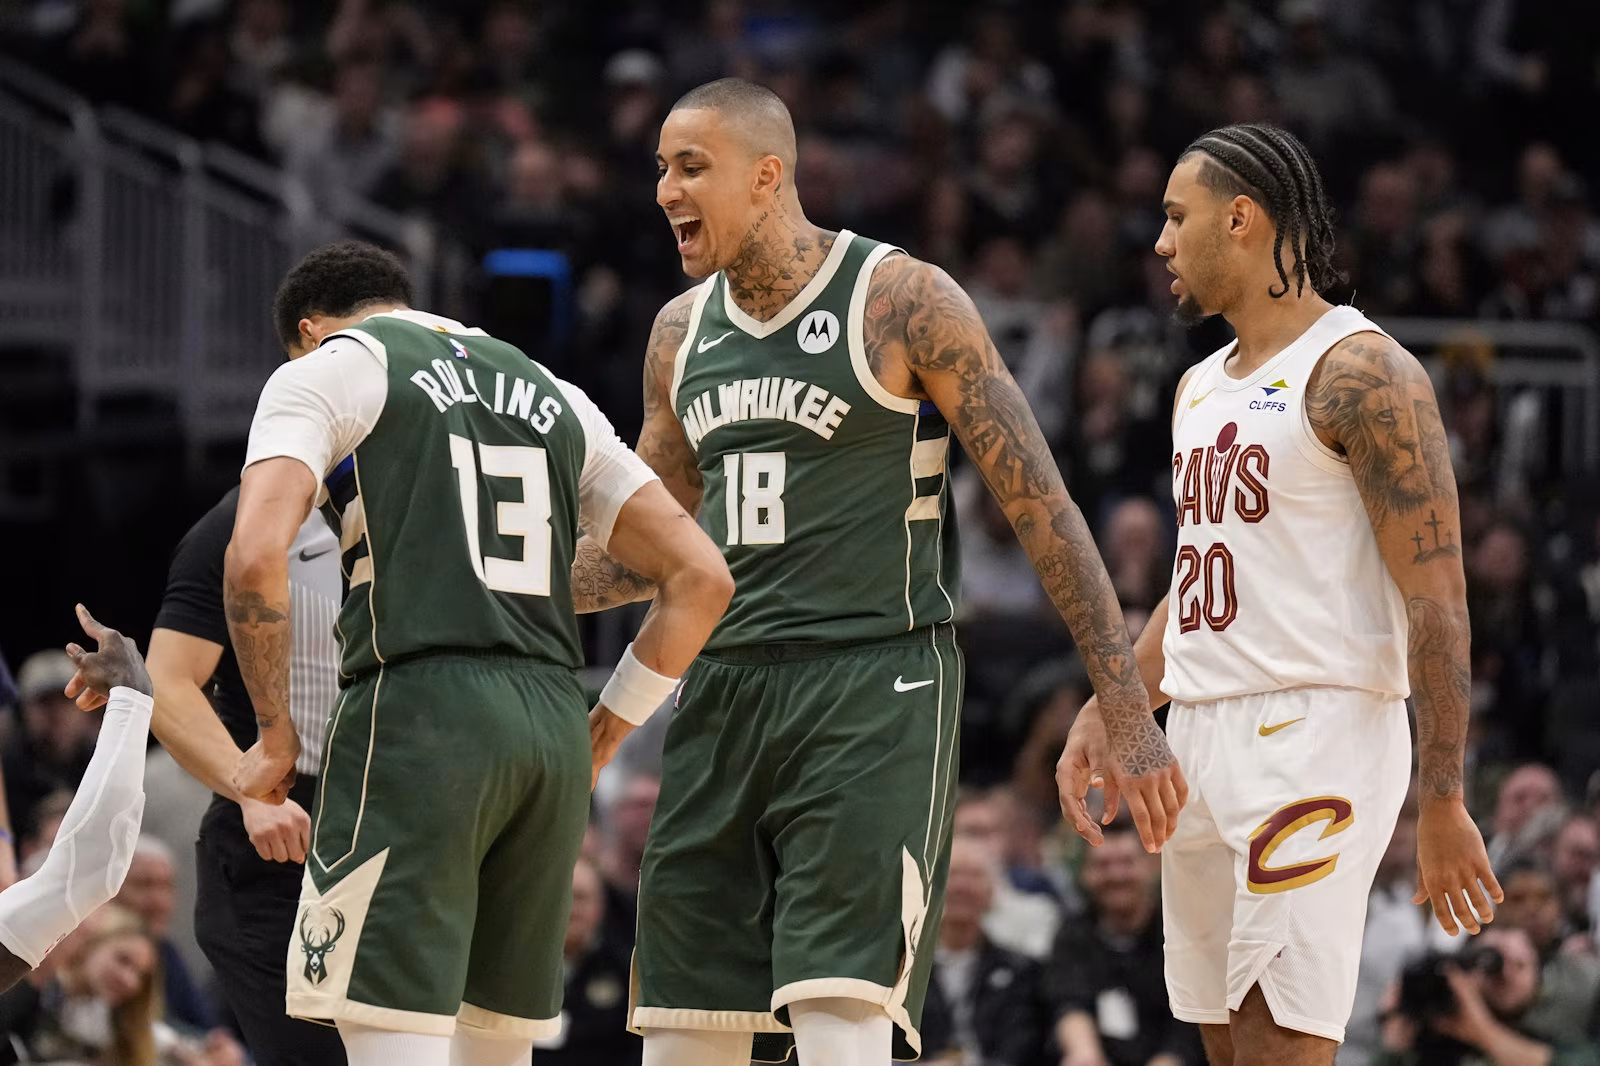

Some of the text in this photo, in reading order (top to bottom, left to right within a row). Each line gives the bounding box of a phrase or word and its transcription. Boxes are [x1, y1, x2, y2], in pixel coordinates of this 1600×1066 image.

[682, 377, 852, 453] MILWAUKEE
[1249, 400, 1287, 412] CLIFFS
[449, 433, 552, 597] 13
[723, 451, 787, 546] 18
[1177, 542, 1238, 635] 20
[1246, 795, 1355, 895] C
